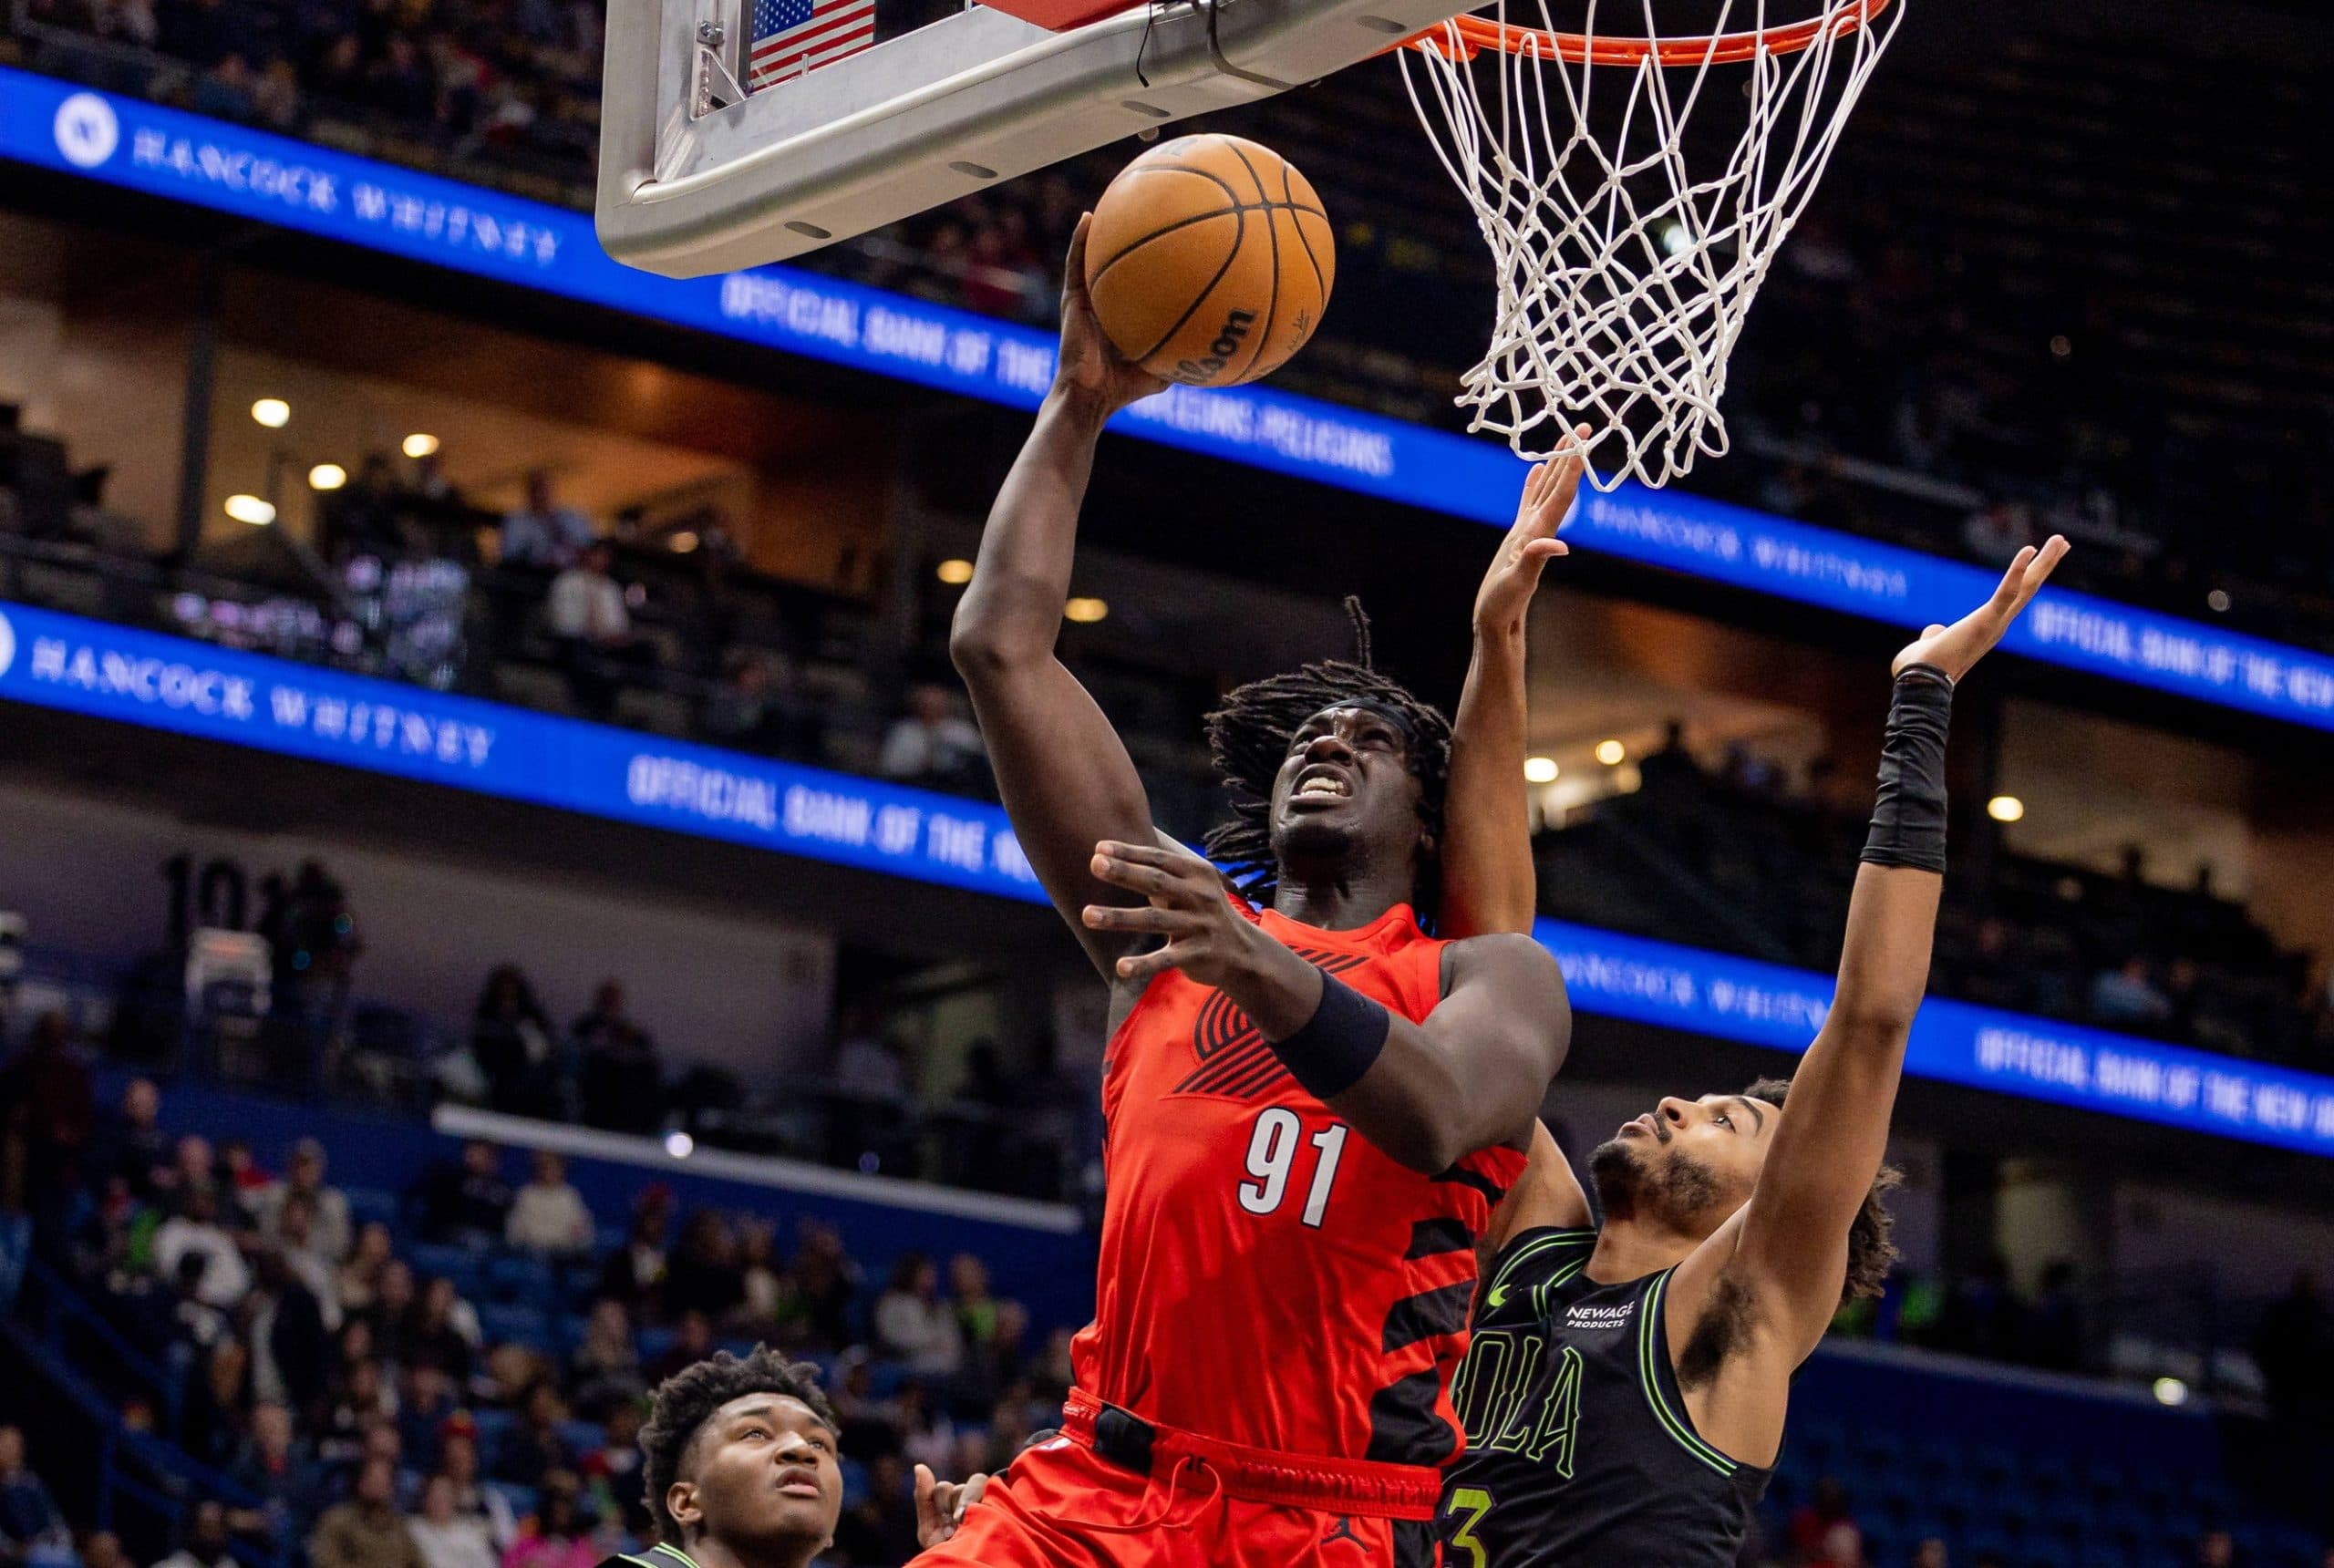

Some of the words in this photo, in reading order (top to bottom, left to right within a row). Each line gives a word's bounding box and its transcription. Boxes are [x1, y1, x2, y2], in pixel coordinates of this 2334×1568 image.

[132, 129, 337, 211] HANCOCK
[352, 183, 559, 263] WHITNEY
[721, 273, 859, 346] OFFICIAL
[863, 306, 945, 365] BANK
[950, 329, 991, 375] OF
[997, 339, 1055, 396] THE
[1589, 498, 1741, 560] HANCOCK
[31, 636, 254, 721] HANCOCK
[271, 685, 493, 767] WHITNEY
[2032, 602, 2131, 663] OFFICIAL
[2141, 628, 2200, 676] BANK
[2206, 645, 2234, 684] OF
[2245, 653, 2279, 698] THE
[627, 754, 777, 830] OFFICIAL
[783, 784, 869, 846] BANK
[874, 804, 922, 854] OF
[927, 813, 986, 872] THE
[1976, 1028, 2091, 1089] OFFICIAL
[2098, 1051, 2160, 1101] BANK
[2164, 1066, 2199, 1109] OF
[2204, 1072, 2248, 1122] THE
[1237, 1106, 1349, 1229] 91
[1565, 1300, 1636, 1320] NEWAGE
[1566, 1318, 1626, 1328] PRODUCTS
[1451, 1330, 1583, 1479] OLA
